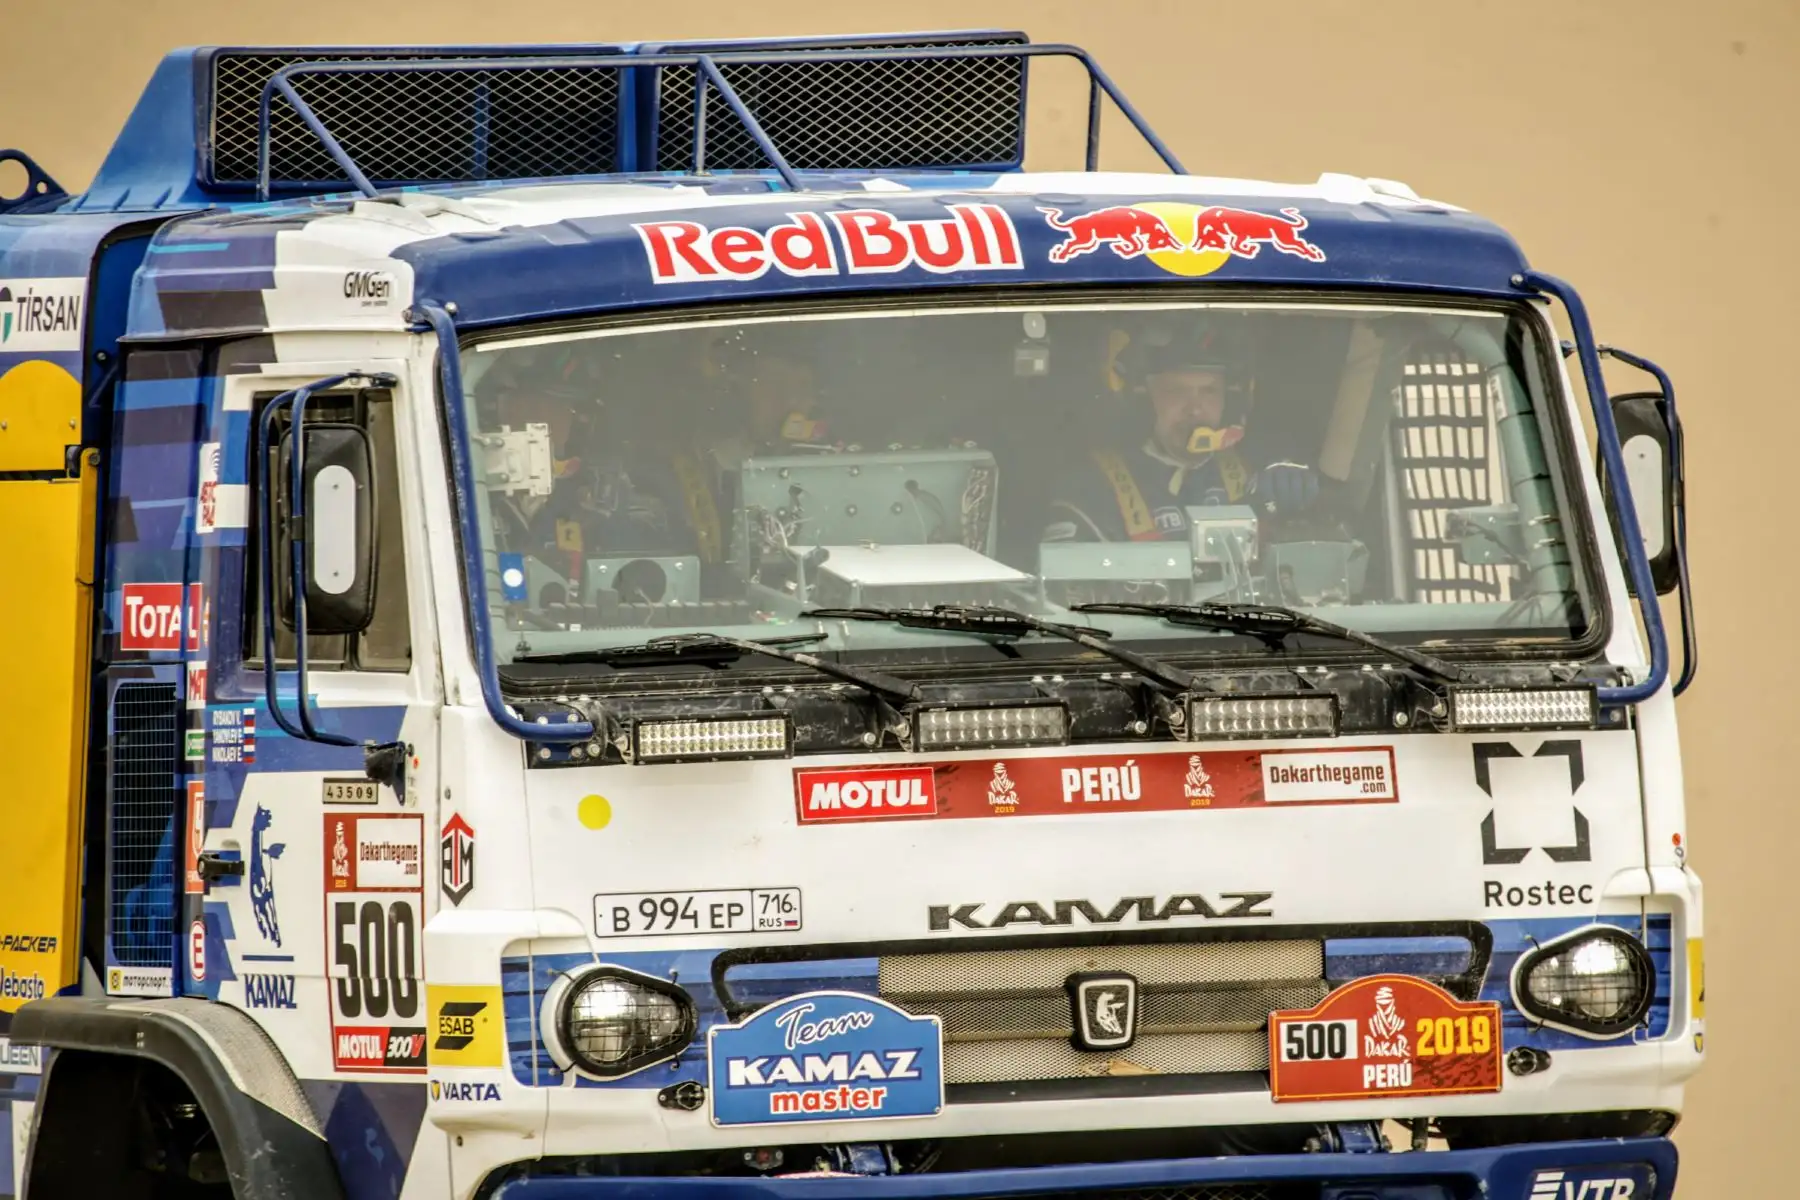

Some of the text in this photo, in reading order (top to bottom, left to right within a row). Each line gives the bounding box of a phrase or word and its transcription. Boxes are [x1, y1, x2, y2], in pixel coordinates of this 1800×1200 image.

[635, 205, 1021, 281] Red Bull
[344, 271, 390, 298] GMGen
[17, 288, 79, 332] TİRSAN
[126, 596, 198, 638] TOTAL
[1061, 760, 1141, 803] PERÚ
[1270, 764, 1385, 784] Dakarthegame
[1360, 782, 1386, 793] .com
[327, 786, 374, 799] 43509
[809, 778, 929, 810] MOTUL
[988, 791, 1019, 806] DAKAR
[1184, 784, 1215, 799] DAKAR
[360, 841, 418, 864] Dakarthegame
[1484, 880, 1593, 907] Rostec
[638, 896, 699, 930] 994
[758, 894, 792, 915] 716
[759, 918, 782, 928] RUS
[928, 891, 1273, 932] KAMAZ
[335, 901, 418, 1018] 500
[0, 967, 44, 999] ebasto
[245, 974, 297, 1009] KAMAZ
[439, 1016, 474, 1035] ESAB
[777, 1004, 873, 1048] Team
[1416, 1015, 1490, 1056] 2019
[338, 1033, 425, 1059] MOTUL 300V
[1286, 1022, 1347, 1060] 500
[1364, 1034, 1410, 1058] DAKAR
[728, 1049, 921, 1087] KAMAZ
[1363, 1060, 1412, 1088] PERÚ
[442, 1083, 500, 1101] VARTA
[772, 1087, 886, 1114] master
